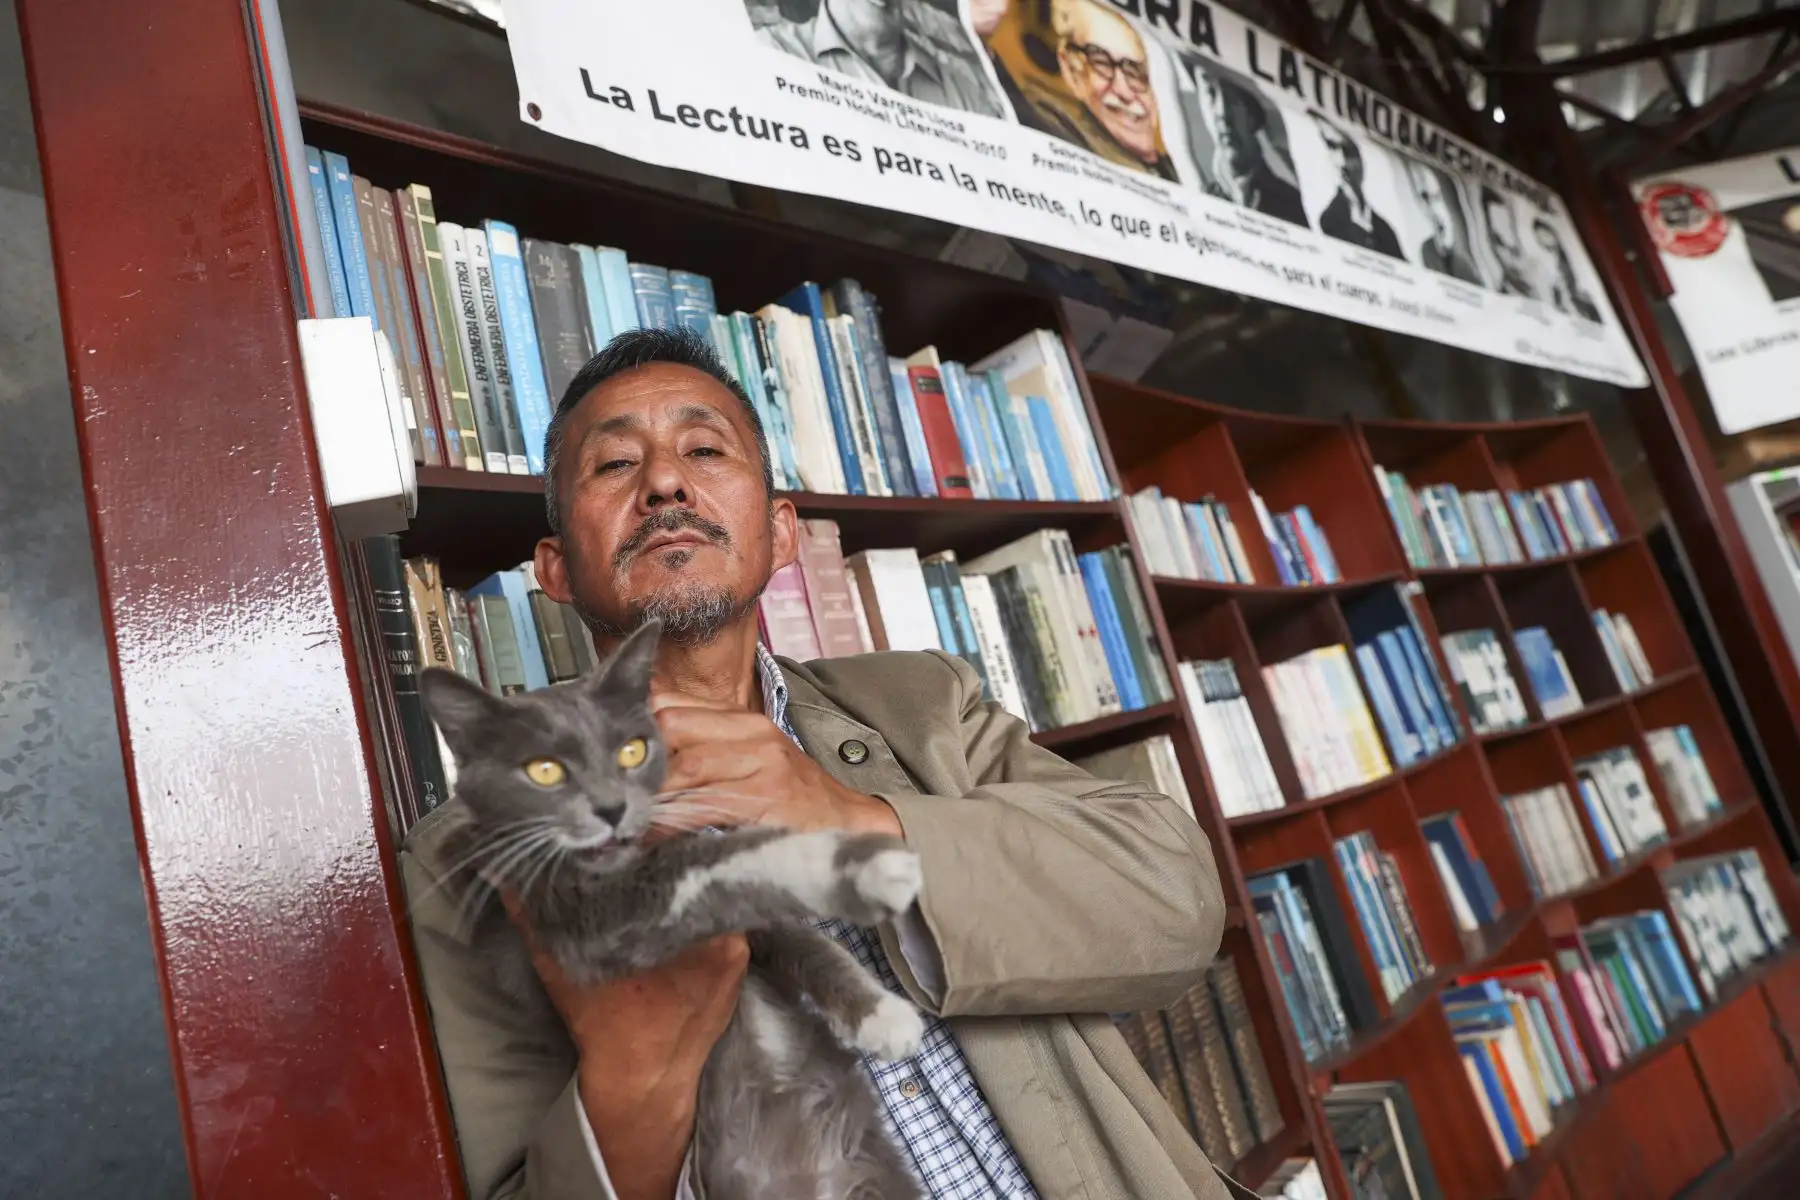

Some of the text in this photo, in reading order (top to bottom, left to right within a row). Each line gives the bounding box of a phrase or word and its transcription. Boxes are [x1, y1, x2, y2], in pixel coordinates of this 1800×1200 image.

[775, 75, 841, 110] Premio
[817, 73, 868, 102] Mario
[579, 67, 634, 111] La
[646, 88, 811, 150] Lectura
[822, 132, 863, 162] es
[873, 144, 945, 181] para
[951, 162, 978, 193] la
[986, 179, 1077, 223] mente,
[1079, 200, 1102, 227] lo
[1110, 211, 1151, 239] que
[1159, 221, 1178, 244] el
[1032, 153, 1079, 176] Premio
[455, 261, 477, 319] OBSTETRICA
[476, 266, 498, 324] OBSTETRICA
[466, 321, 488, 382] ENFERMERIA
[487, 325, 510, 386] ENFERMERIA
[427, 609, 447, 662] GENETICA
